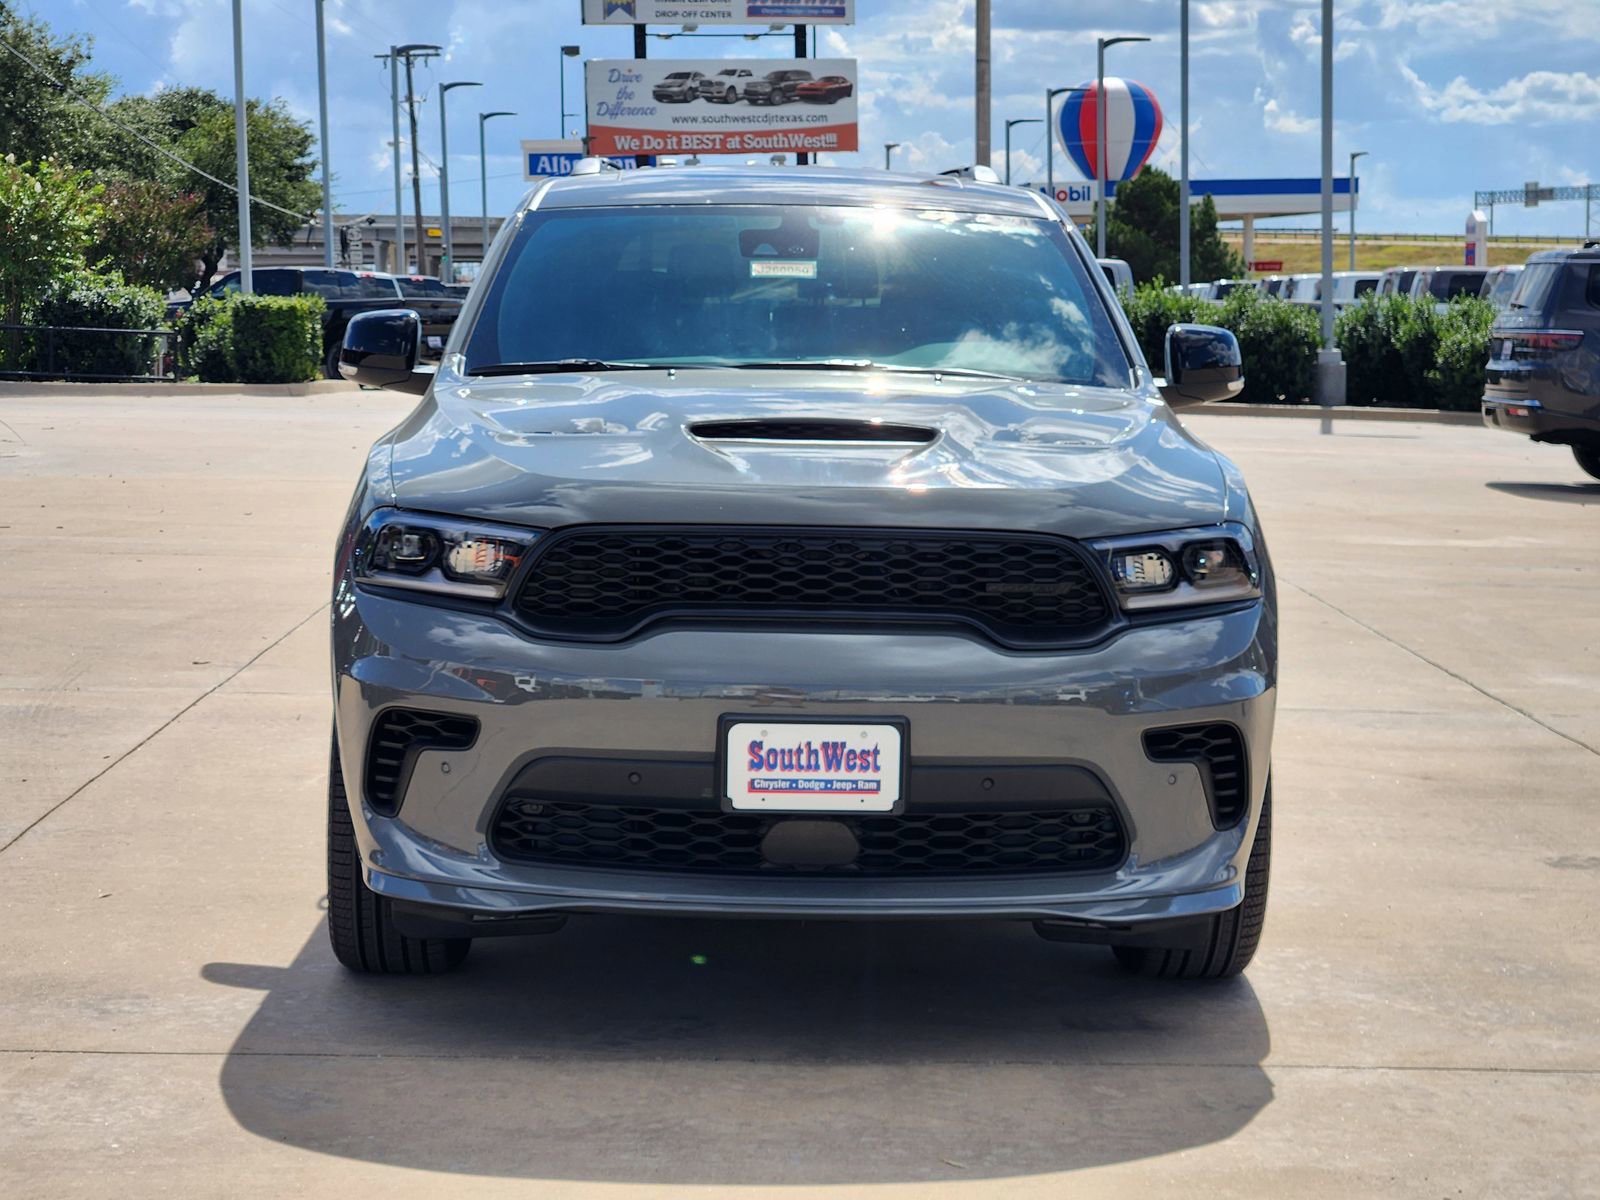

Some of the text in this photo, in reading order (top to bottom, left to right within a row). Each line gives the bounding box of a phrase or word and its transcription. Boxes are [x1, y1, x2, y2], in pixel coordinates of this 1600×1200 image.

[699, 10, 733, 18] CENTER
[608, 68, 642, 83] Drive
[616, 86, 635, 100] the
[596, 101, 657, 120] Difference
[671, 112, 828, 126] www.southwestcdjrtexas.com
[613, 132, 838, 151] We Do it BEST at SouthWest!!!
[747, 740, 881, 773] SouthWest
[754, 778, 878, 791] Chrysler Dodge Jeep Ram
